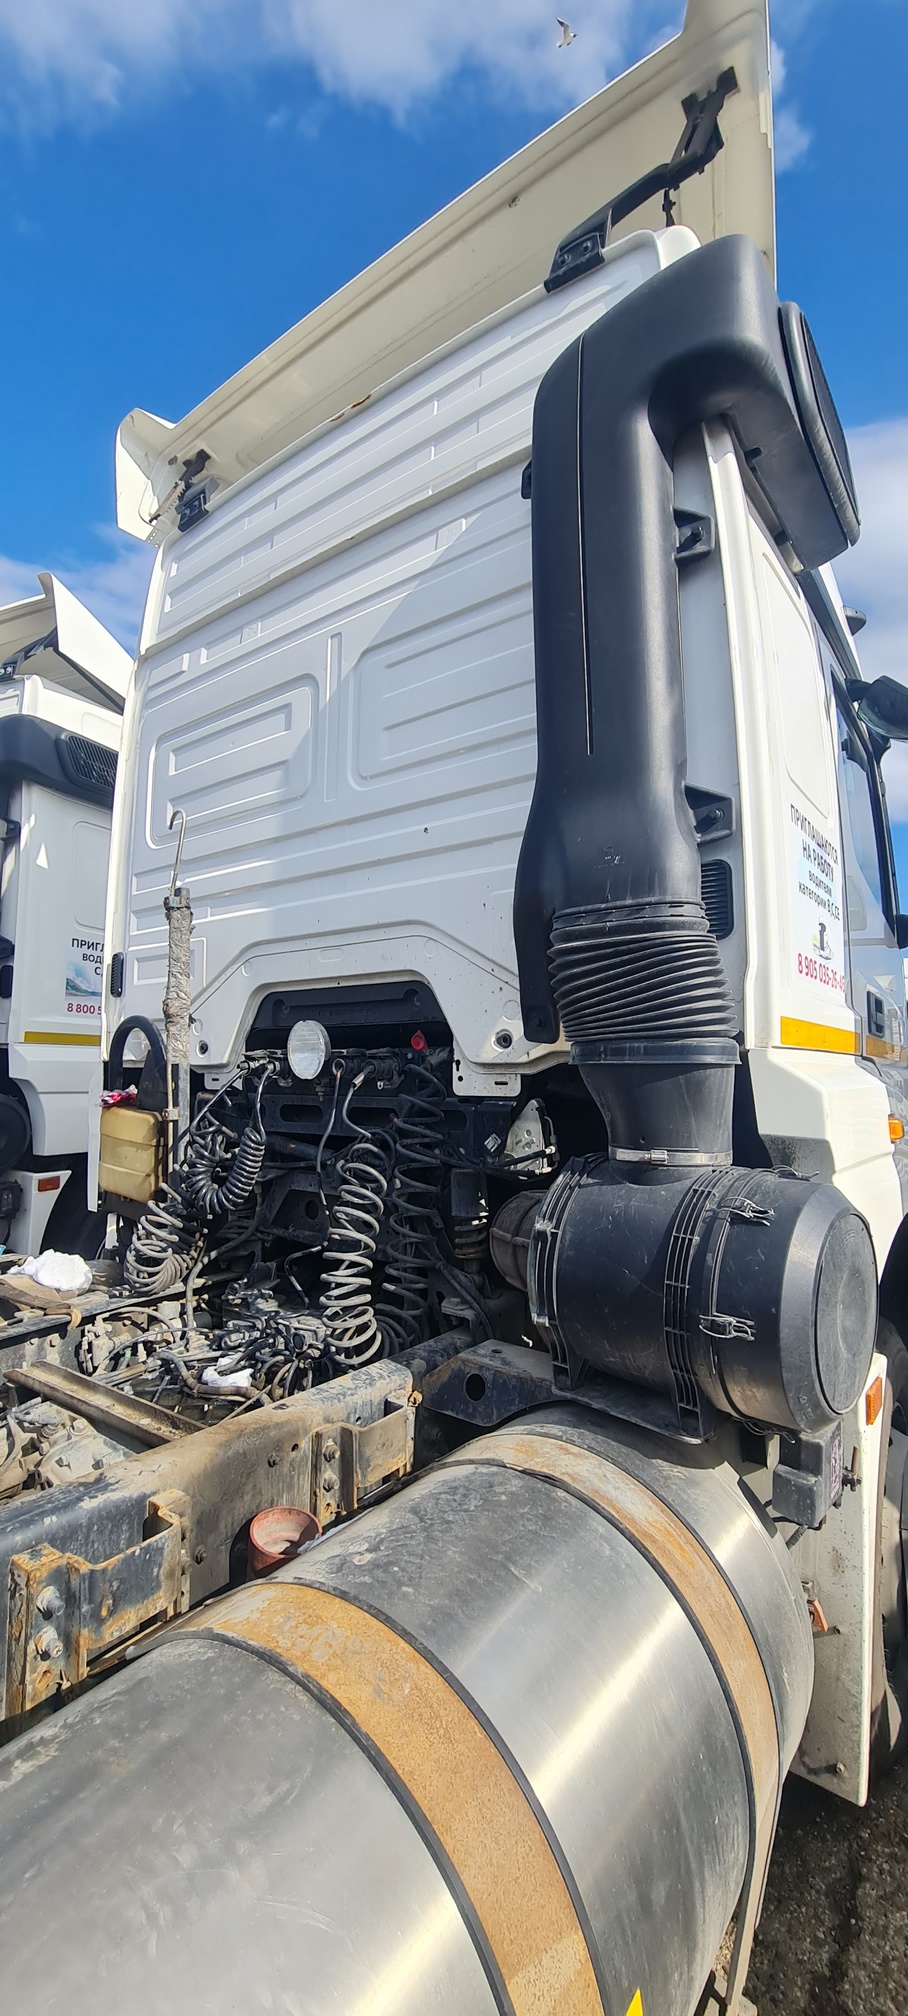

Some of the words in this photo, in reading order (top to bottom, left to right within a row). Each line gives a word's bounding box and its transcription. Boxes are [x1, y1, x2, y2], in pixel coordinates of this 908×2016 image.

[790, 803, 838, 866] ПРИГЛАШАЮТСЯ
[802, 838, 813, 864] НА
[812, 848, 834, 882] РАБОТУ
[797, 953, 804, 974] 8
[804, 956, 818, 980] 905
[67, 1003, 74, 1012] 8
[75, 1003, 96, 1014] 800
